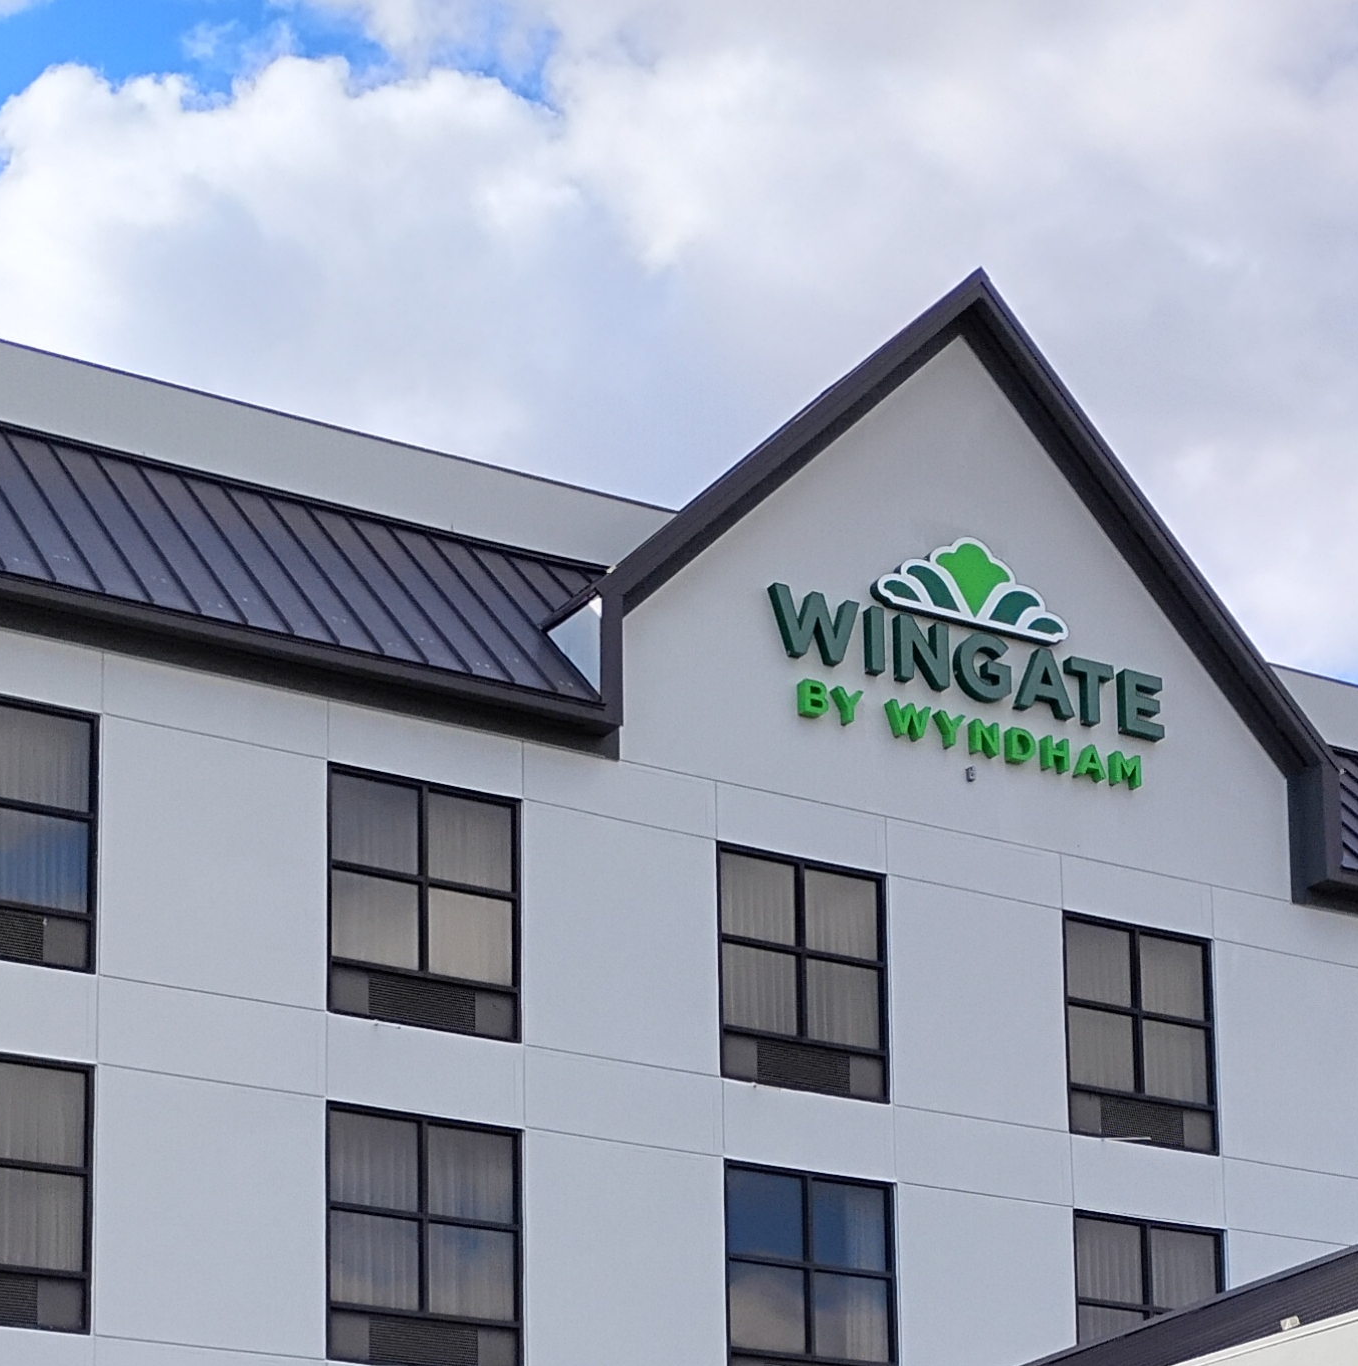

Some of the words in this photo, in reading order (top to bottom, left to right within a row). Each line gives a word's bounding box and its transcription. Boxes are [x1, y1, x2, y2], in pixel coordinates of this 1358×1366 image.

[767, 582, 1165, 743] WINGATE
[797, 678, 864, 726] BY
[884, 698, 1142, 790] WYNDHAM
